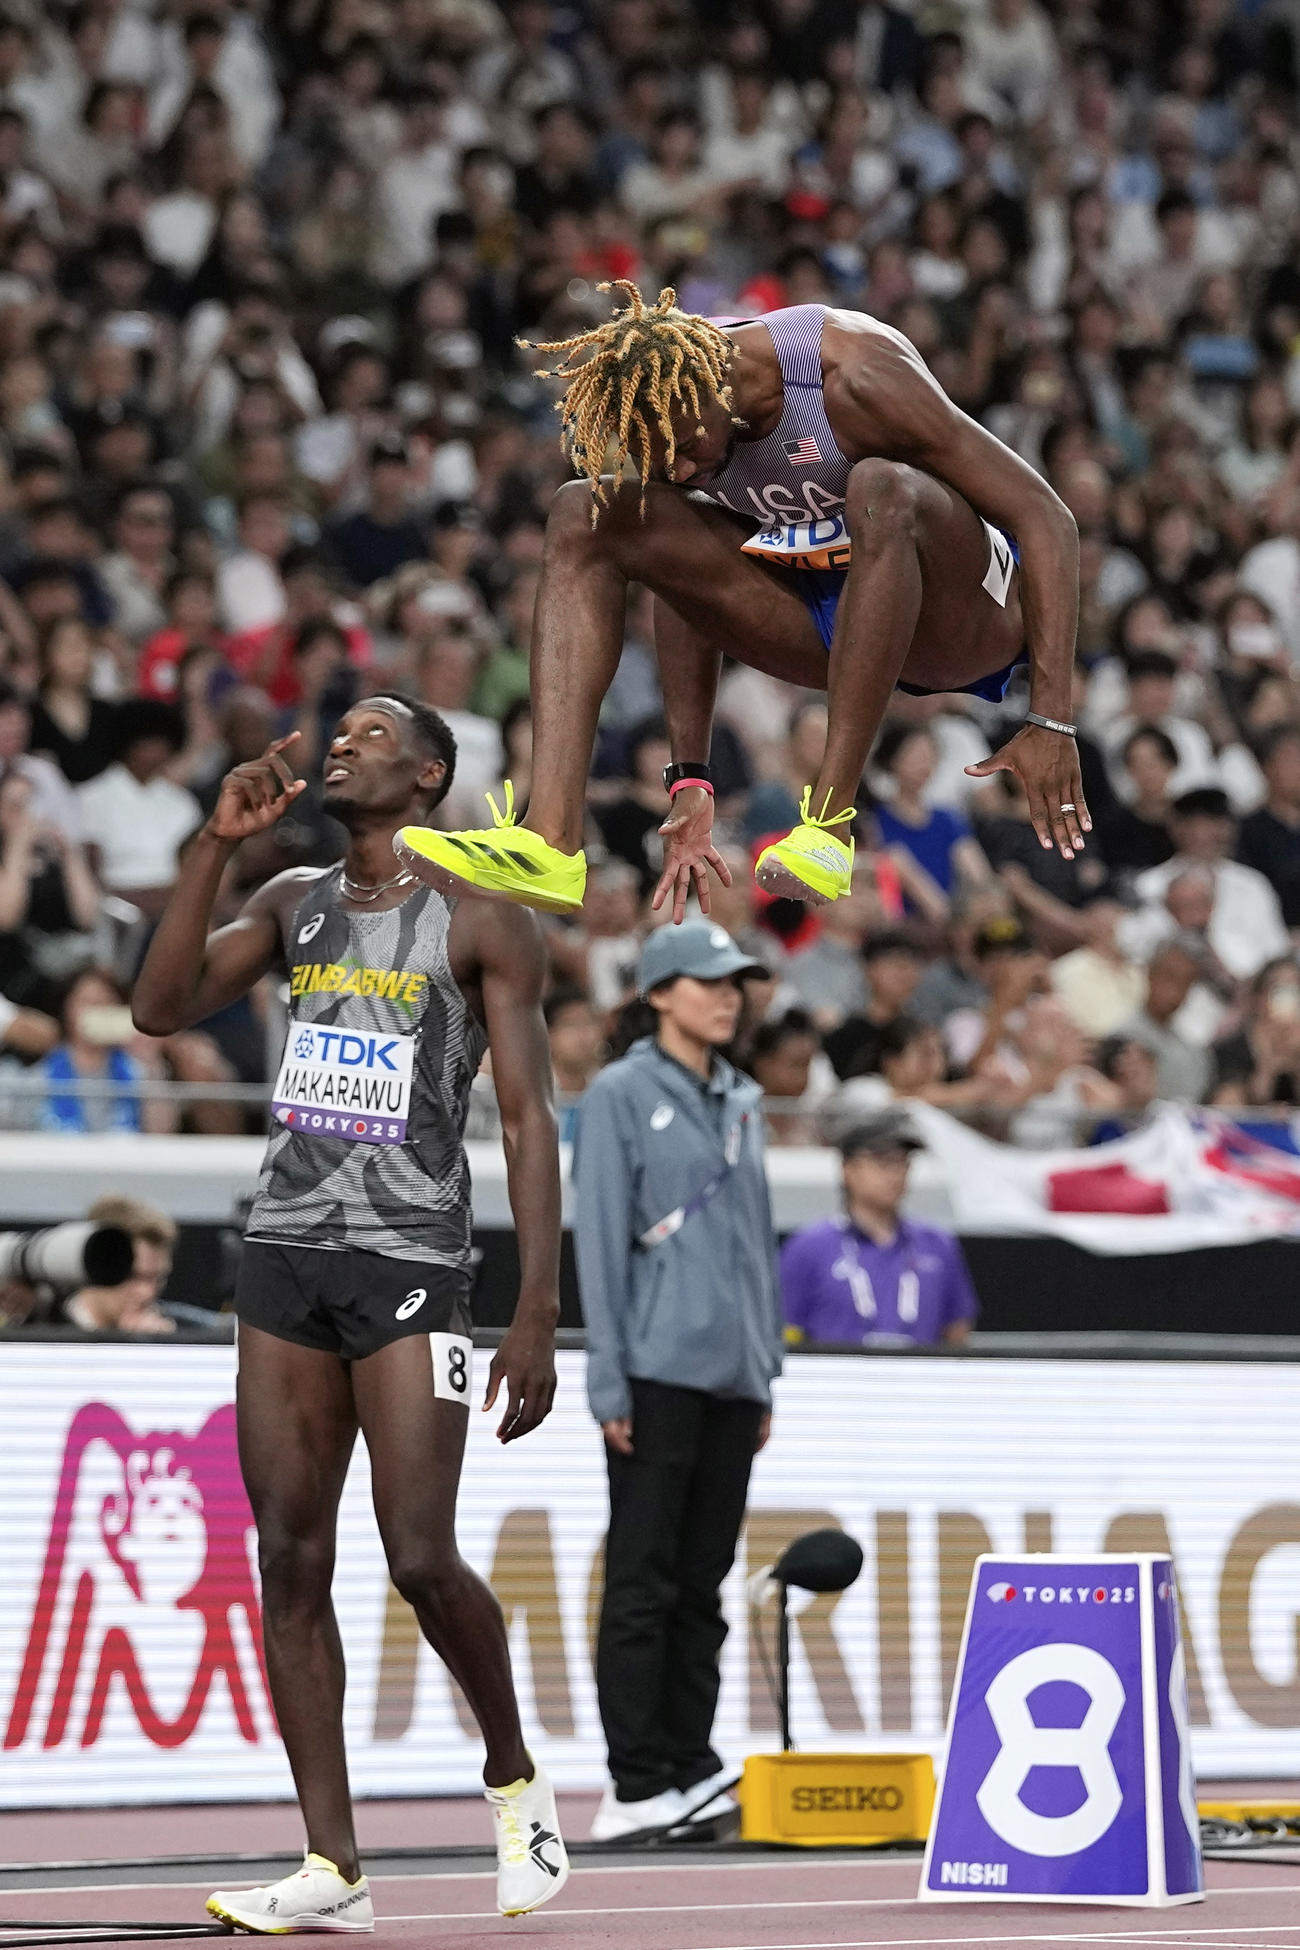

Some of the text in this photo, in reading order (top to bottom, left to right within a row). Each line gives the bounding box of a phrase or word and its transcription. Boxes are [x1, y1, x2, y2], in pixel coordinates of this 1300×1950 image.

[716, 481, 846, 525] USA
[291, 963, 427, 1003] ZIMBABWE
[317, 1032, 400, 1071] TDK
[280, 1068, 403, 1112] MAKARAWU
[448, 1345, 467, 1393] 8
[976, 1642, 1126, 1857] 8
[791, 1786, 904, 1813] SEIKO
[940, 1861, 1009, 1886] NISHI
